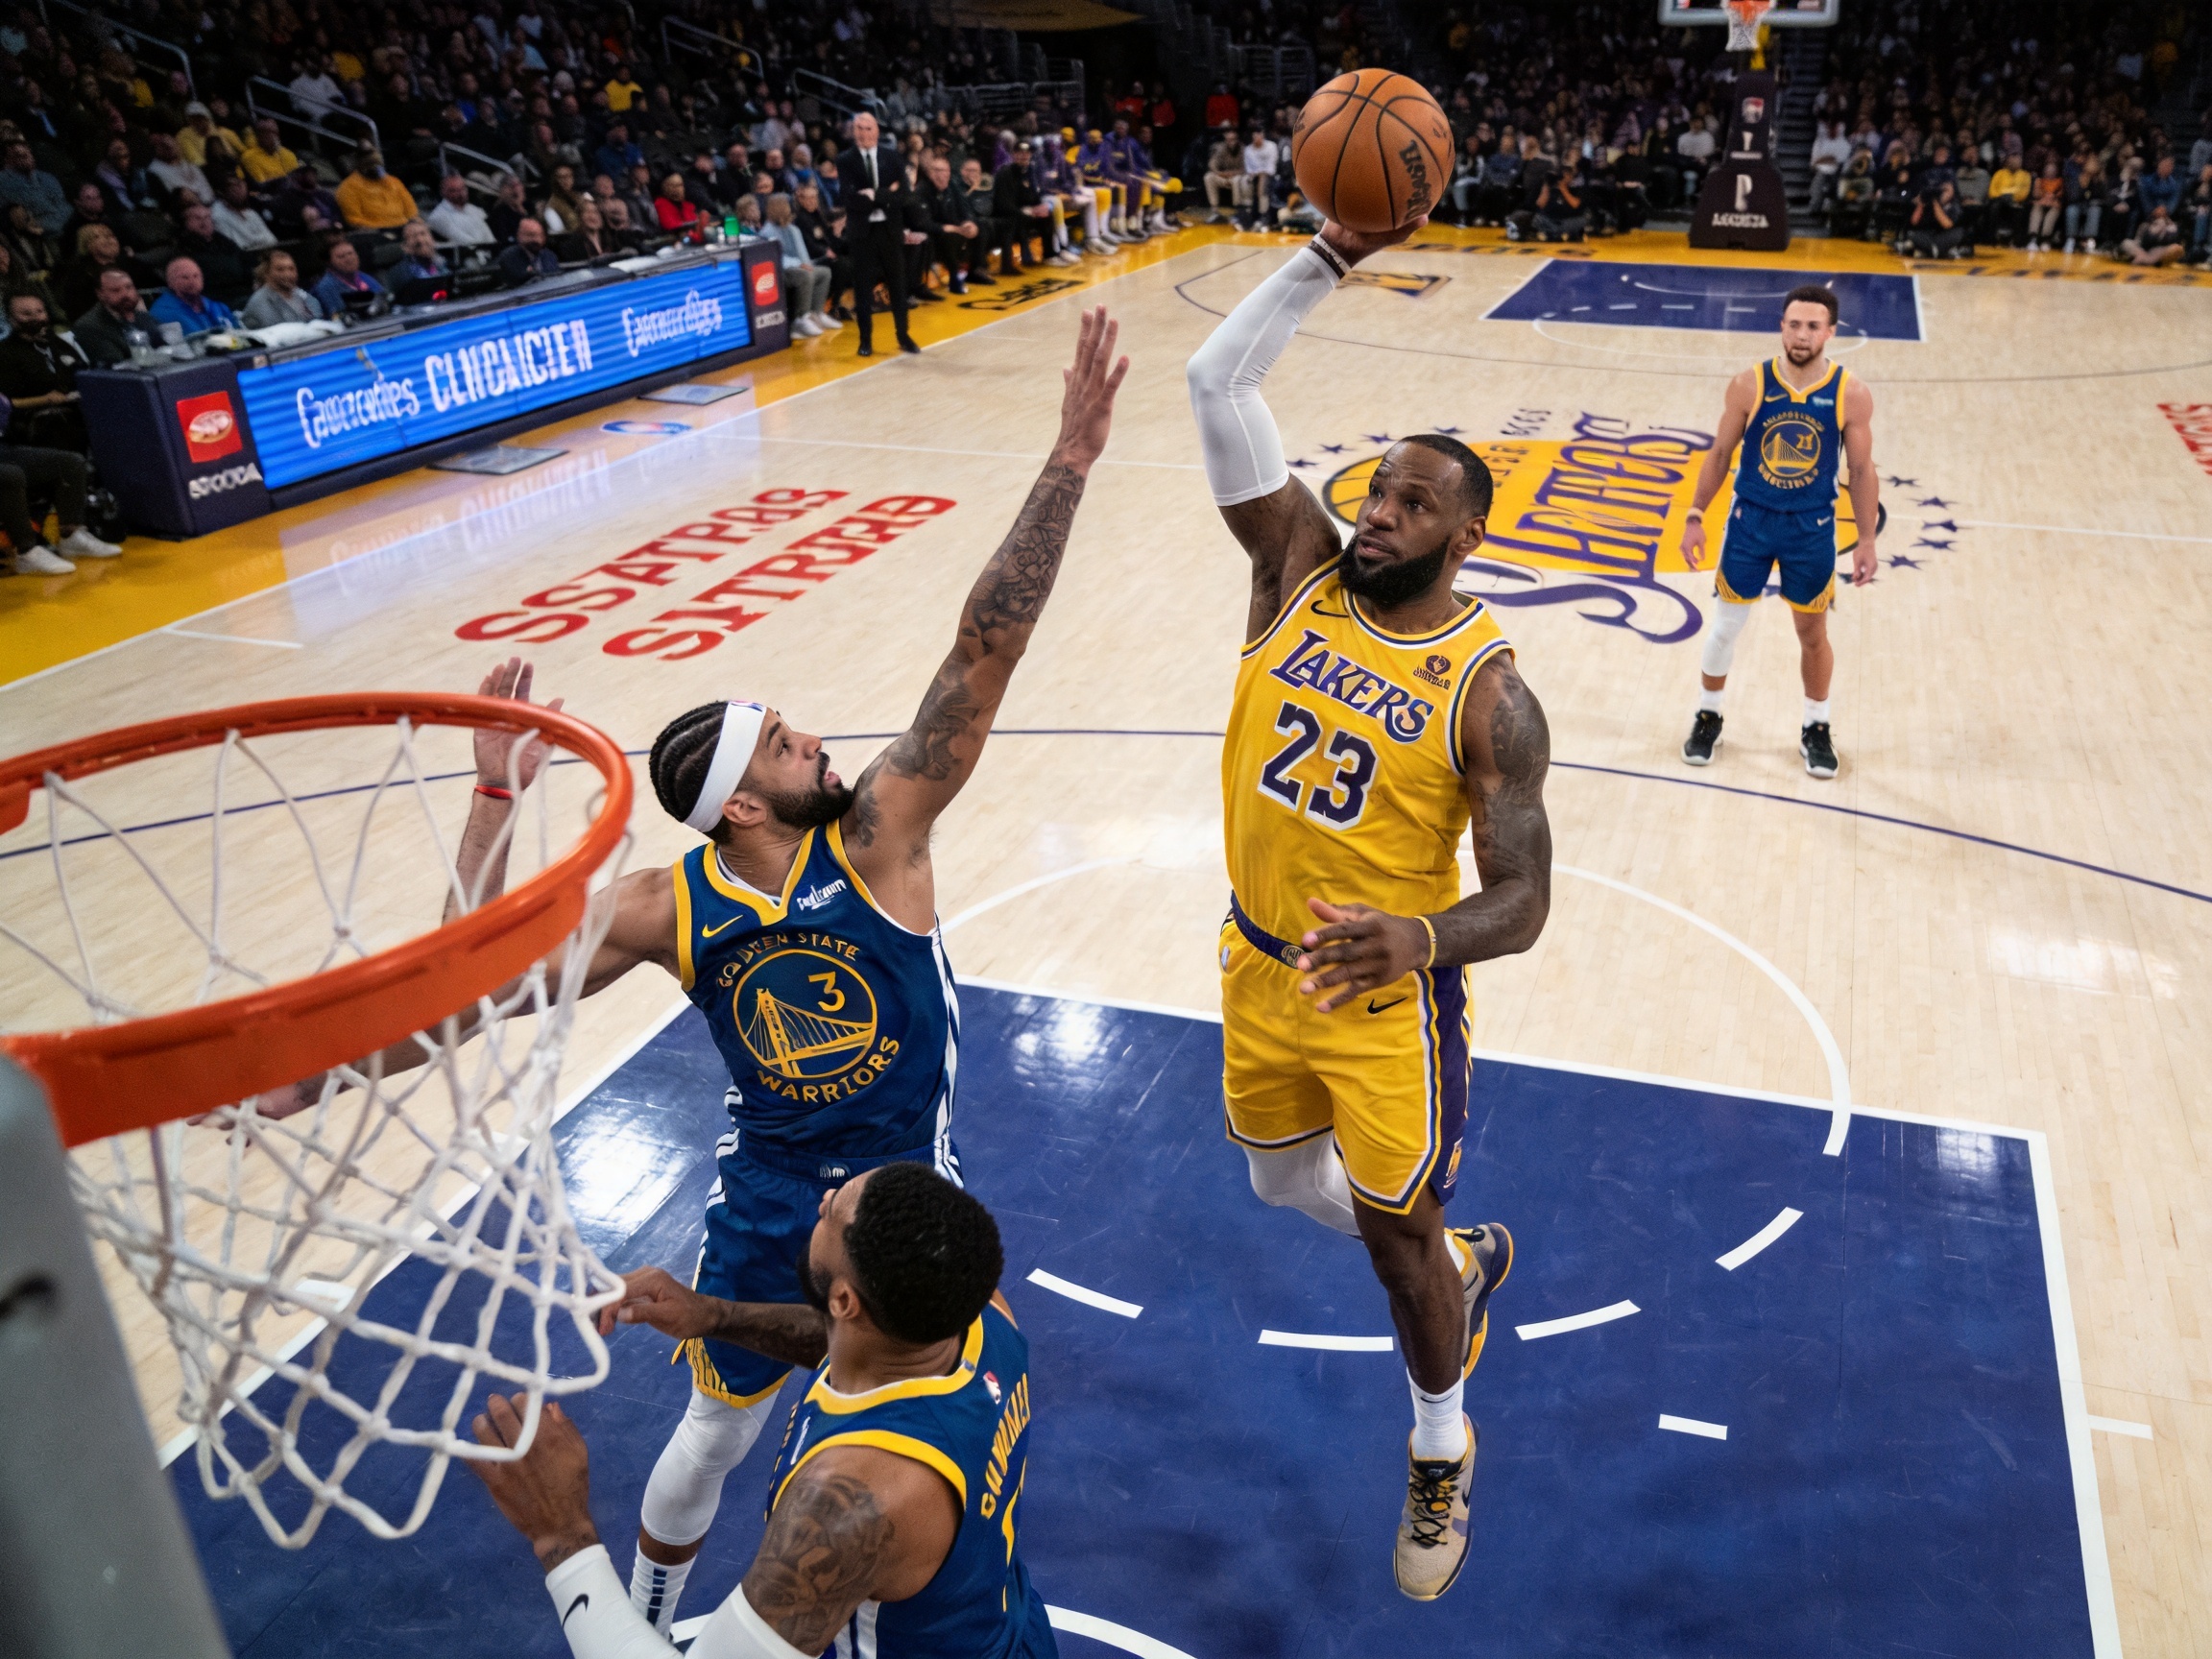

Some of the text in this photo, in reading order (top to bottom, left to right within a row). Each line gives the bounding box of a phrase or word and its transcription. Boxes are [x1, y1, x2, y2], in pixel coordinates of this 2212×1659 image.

[1268, 628, 1435, 744] LAKERS
[1257, 699, 1379, 831] 23
[797, 932, 860, 961] STATE
[808, 971, 846, 1012] 3
[757, 1036, 900, 1103] WARRIORS
